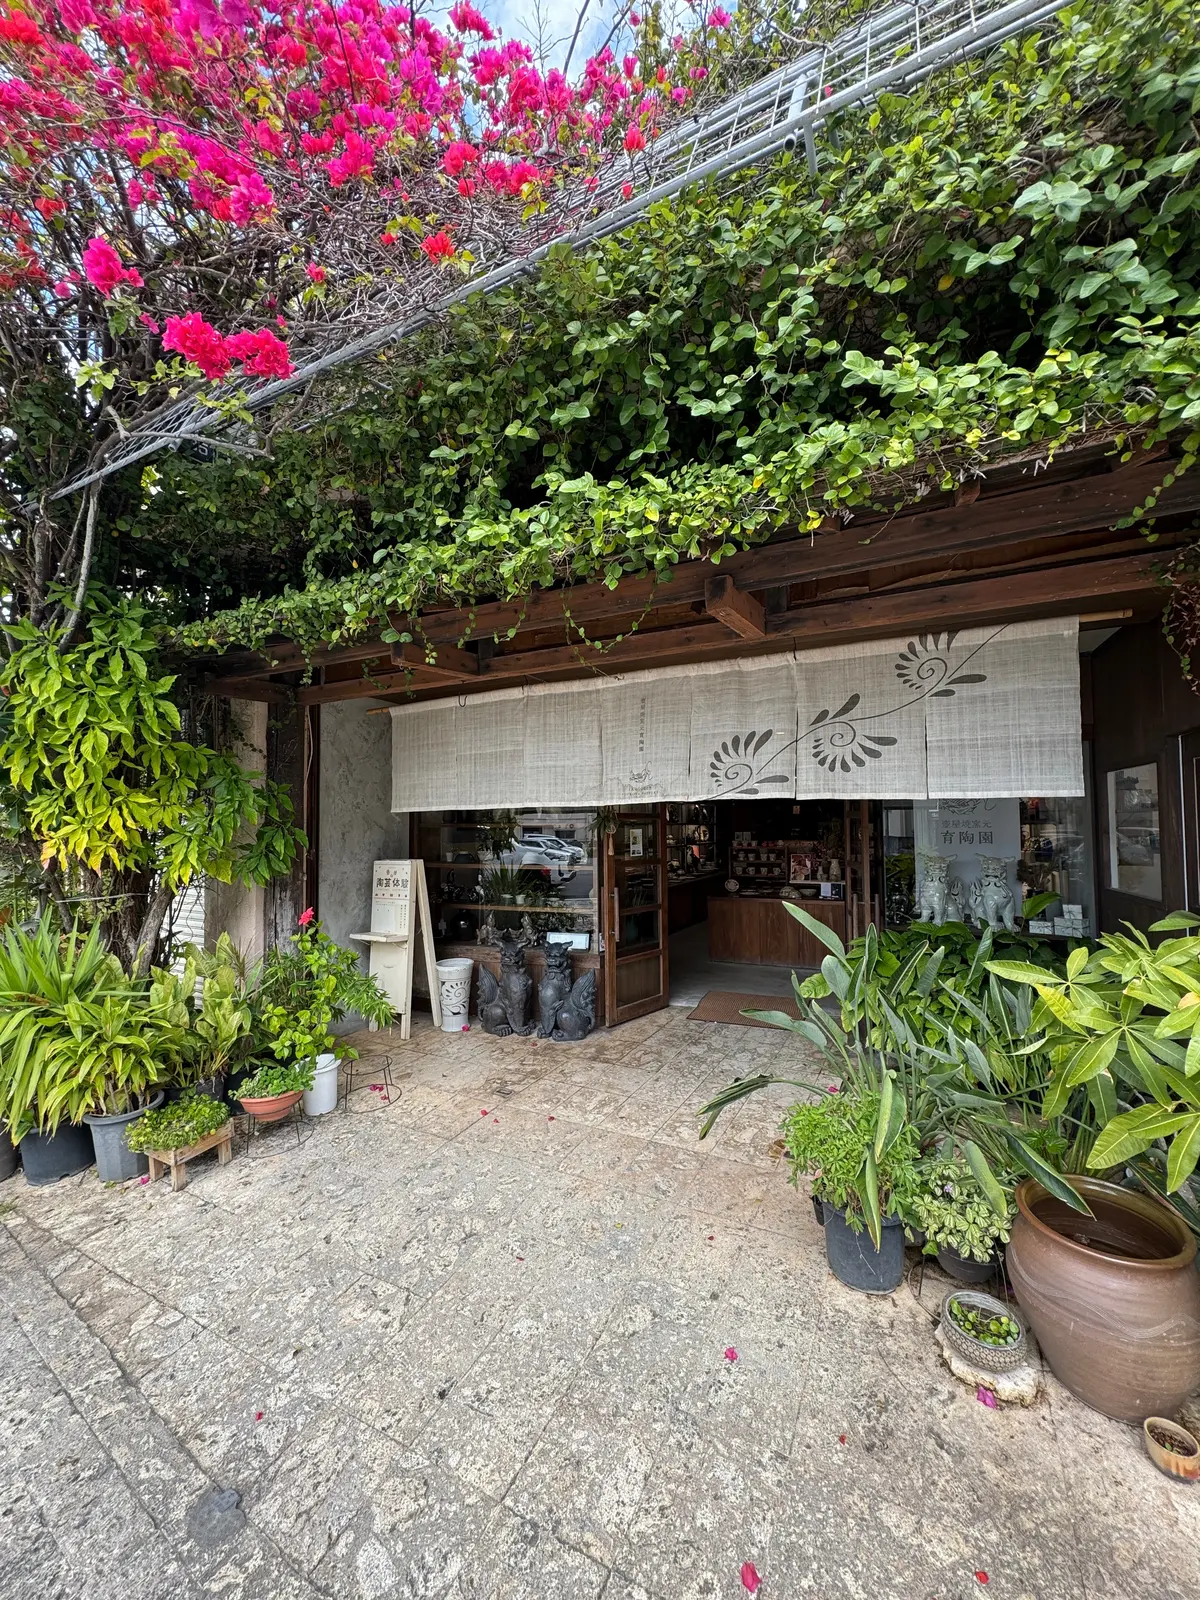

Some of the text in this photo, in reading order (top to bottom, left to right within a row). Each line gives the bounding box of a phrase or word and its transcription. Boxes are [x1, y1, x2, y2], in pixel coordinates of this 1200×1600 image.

[940, 830, 993, 844] 育陶園
[376, 877, 409, 889] 陶芸体験
